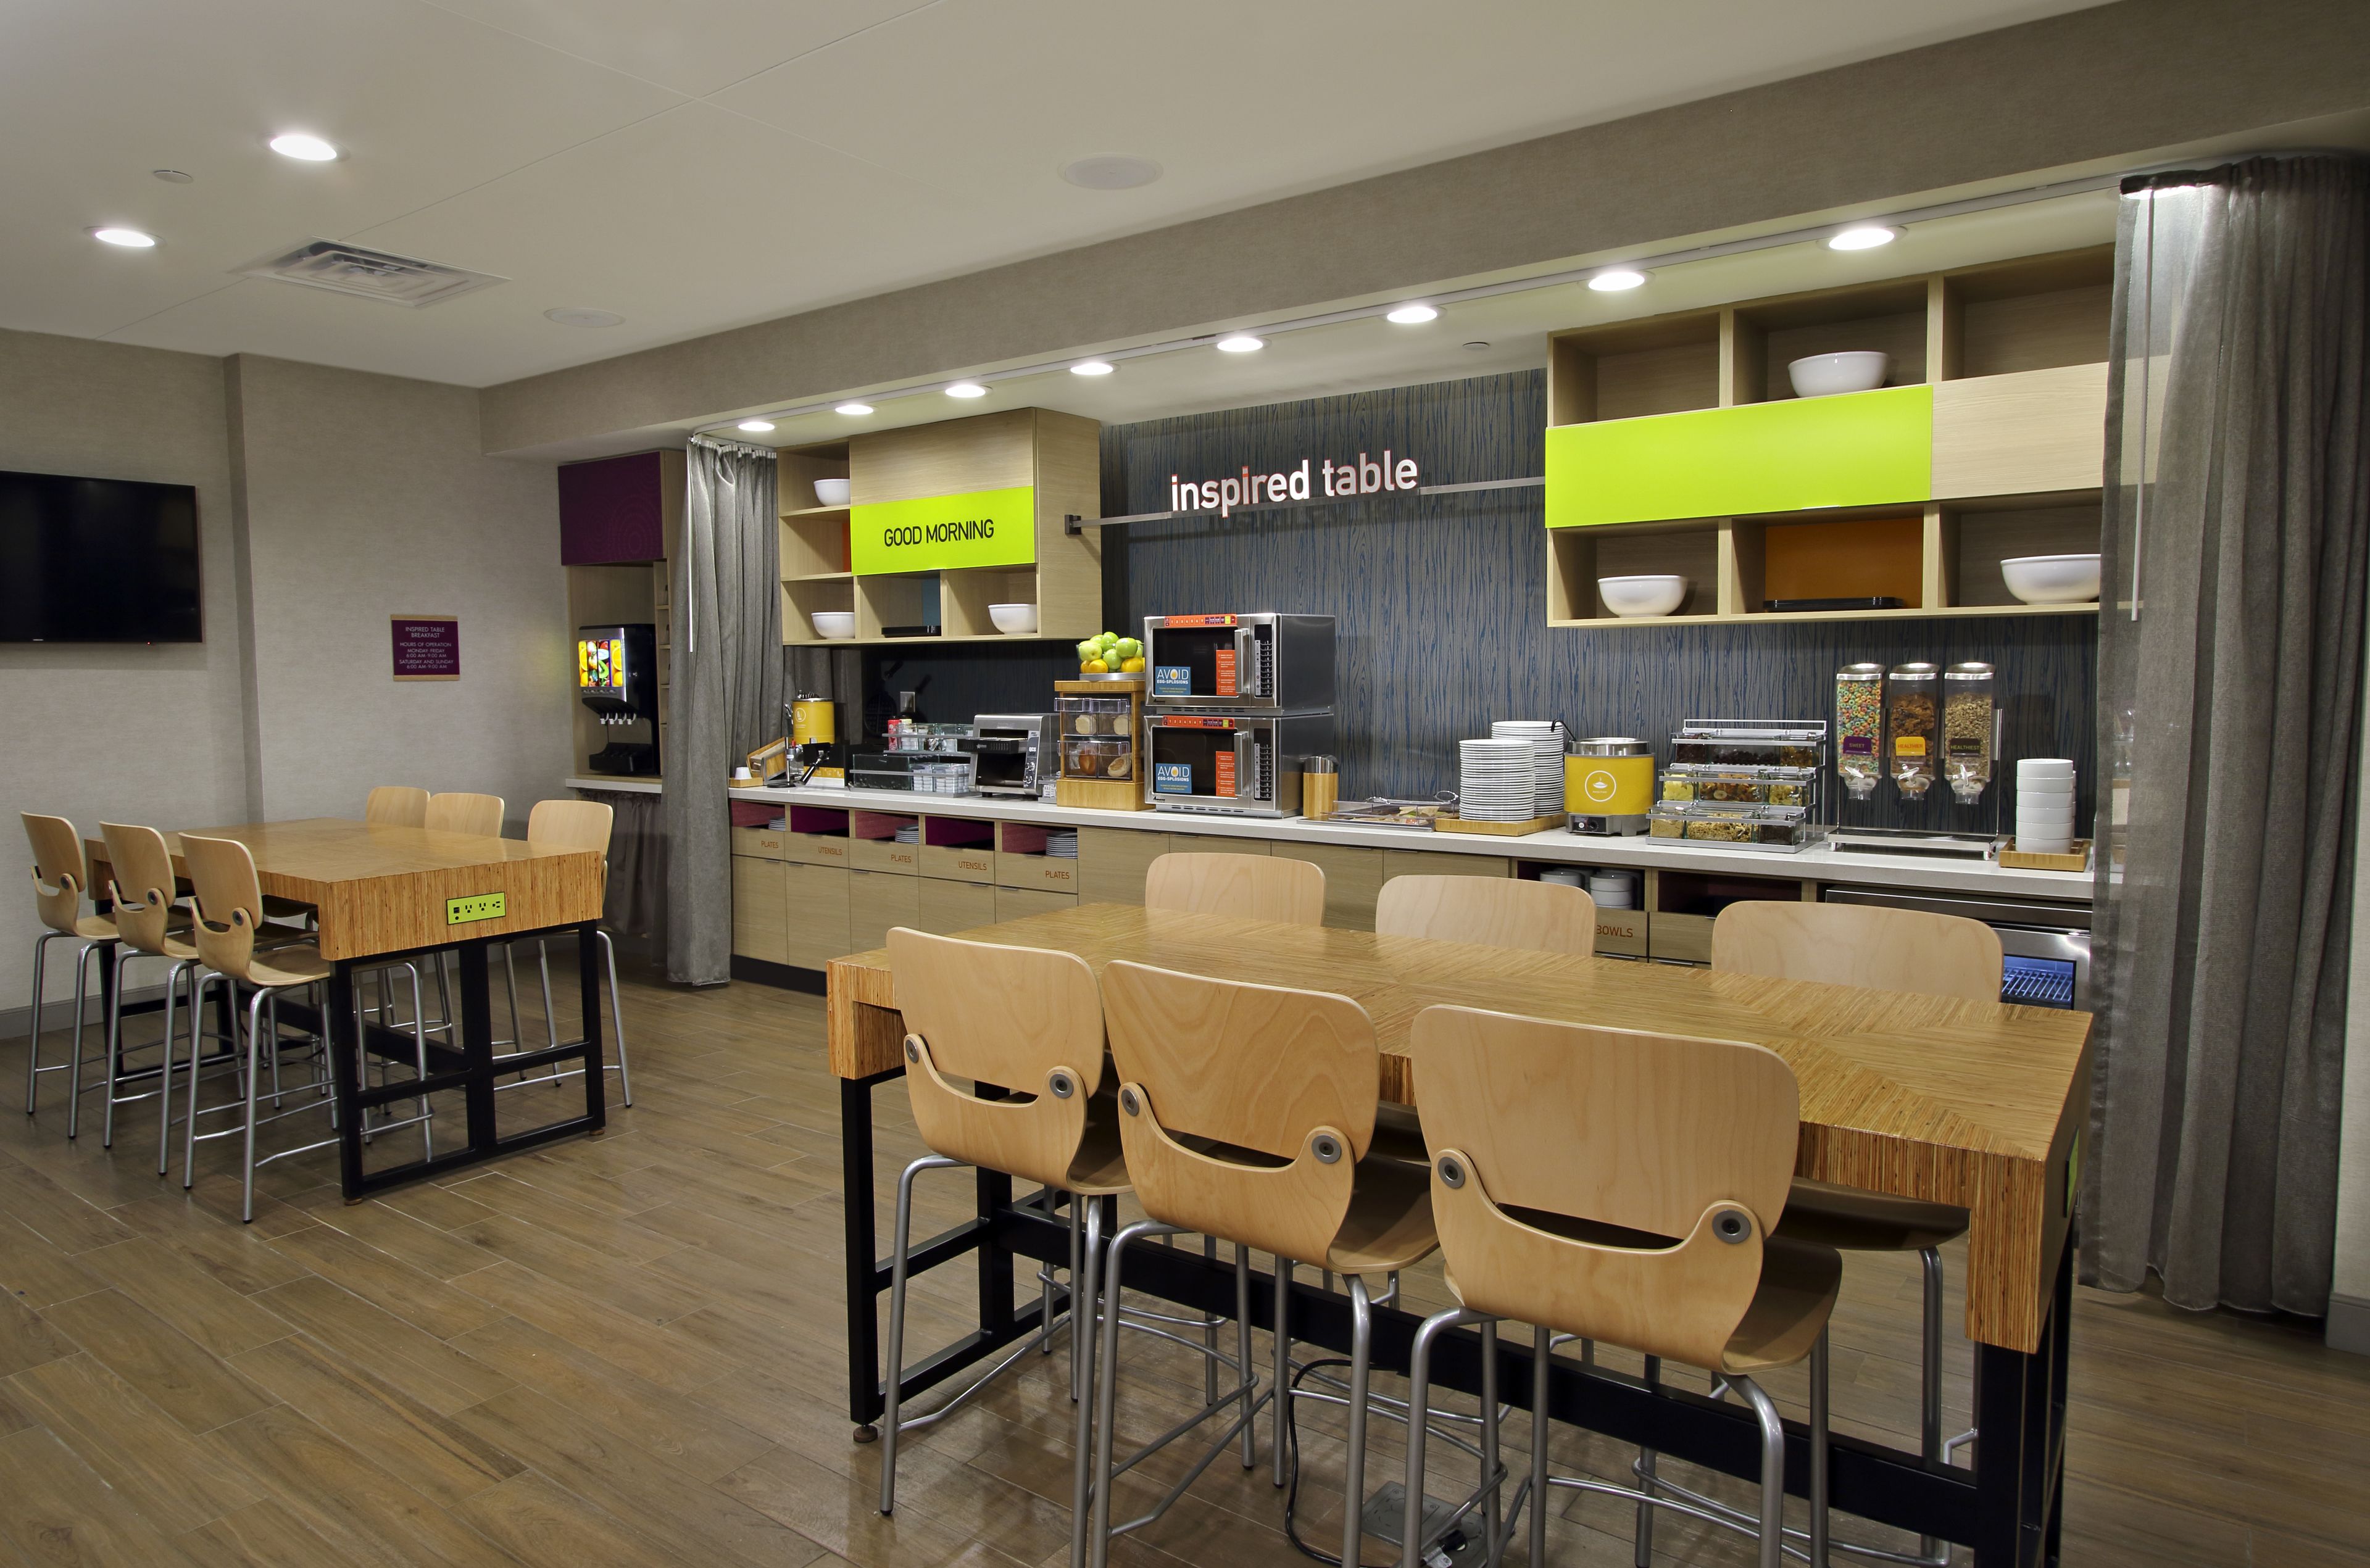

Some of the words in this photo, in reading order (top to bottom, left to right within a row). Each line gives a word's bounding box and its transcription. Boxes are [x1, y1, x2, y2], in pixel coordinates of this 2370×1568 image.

[1171, 459, 1310, 518] inspired
[1322, 449, 1418, 496] table
[884, 526, 922, 547] GOOD
[926, 519, 994, 544] MORNING
[1157, 669, 1189, 679] AVOID
[1158, 766, 1189, 777] AVOID
[761, 840, 779, 848] PLATES
[818, 847, 842, 855] UTENSILS
[891, 854, 912, 863] PLATES
[958, 861, 987, 870] UTENSILS
[1045, 871, 1070, 879] PLATES
